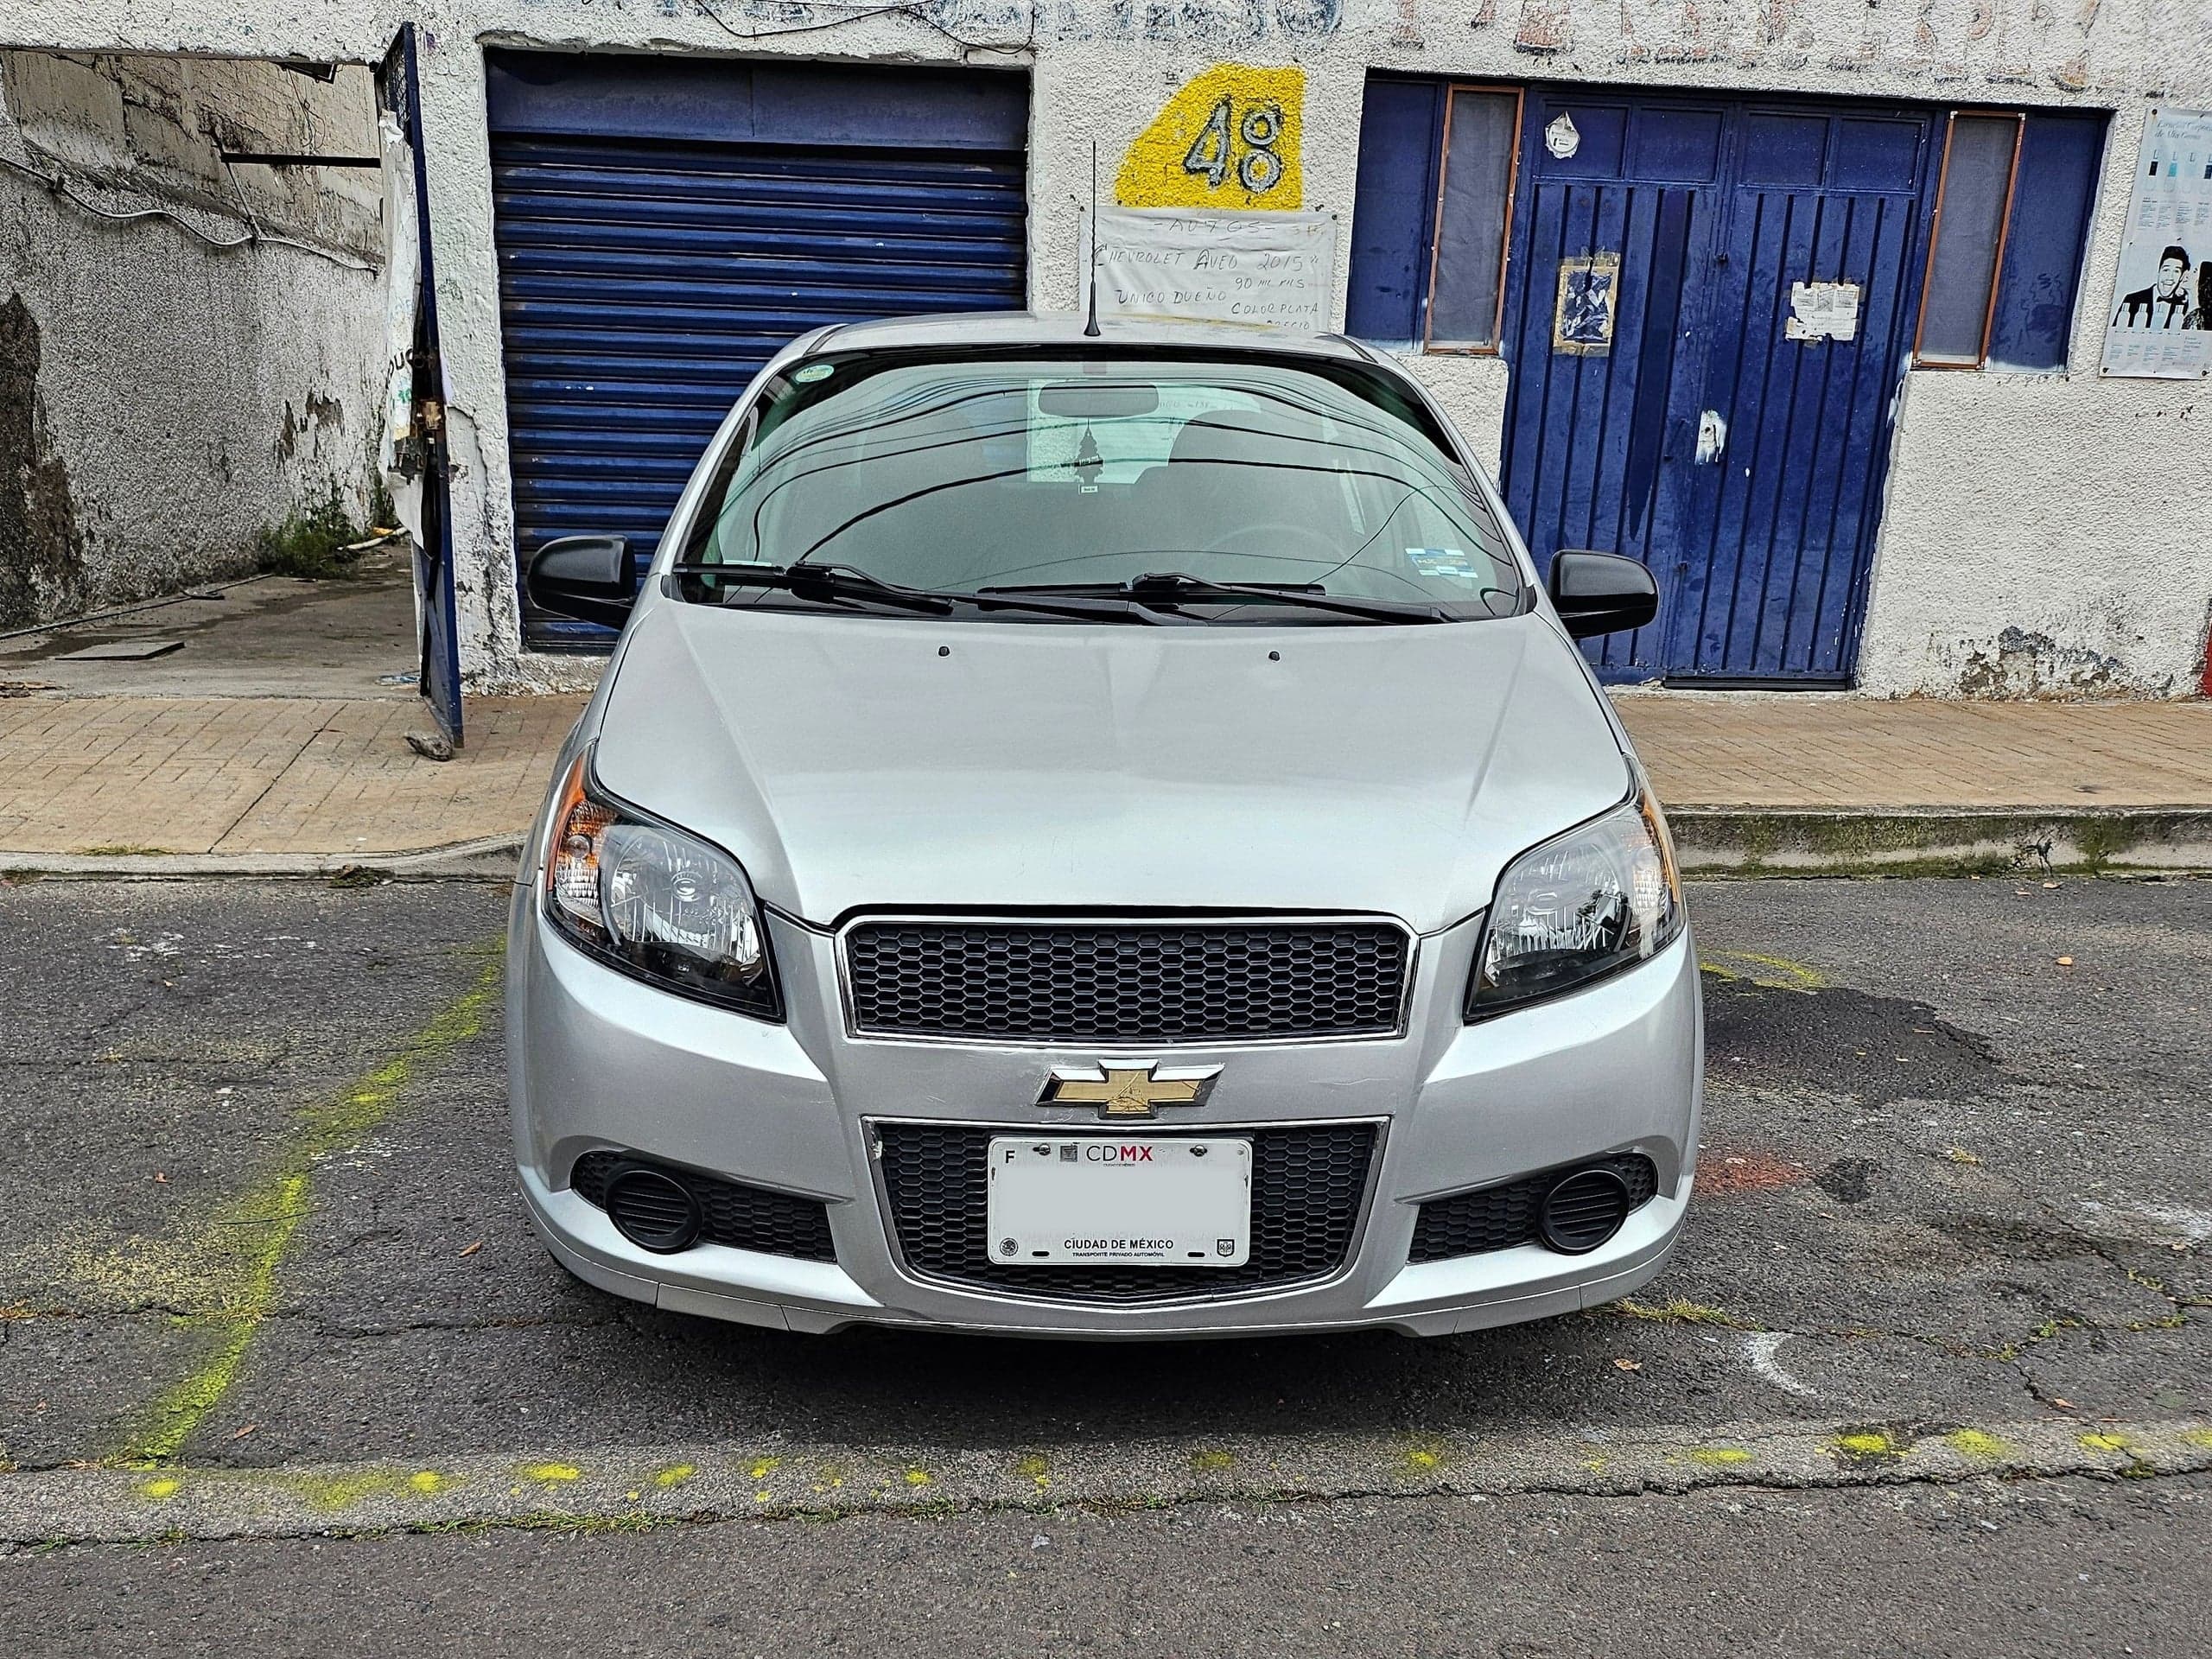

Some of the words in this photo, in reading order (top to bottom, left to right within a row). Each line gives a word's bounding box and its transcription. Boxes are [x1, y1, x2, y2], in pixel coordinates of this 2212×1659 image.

[1183, 93, 1283, 194] 48
[1094, 243, 1185, 266] CHEVROLET
[1192, 249, 1238, 270] AVEO
[1235, 277, 1253, 291] 90
[1114, 289, 1166, 305] UNICO
[1230, 302, 1275, 315] COLOR
[1005, 1150, 1015, 1164] F
[1086, 1145, 1154, 1161] CDMX
[1064, 1238, 1108, 1249] CIUDAD
[1111, 1239, 1127, 1249] DE
[1129, 1237, 1174, 1249] MÉXICO
